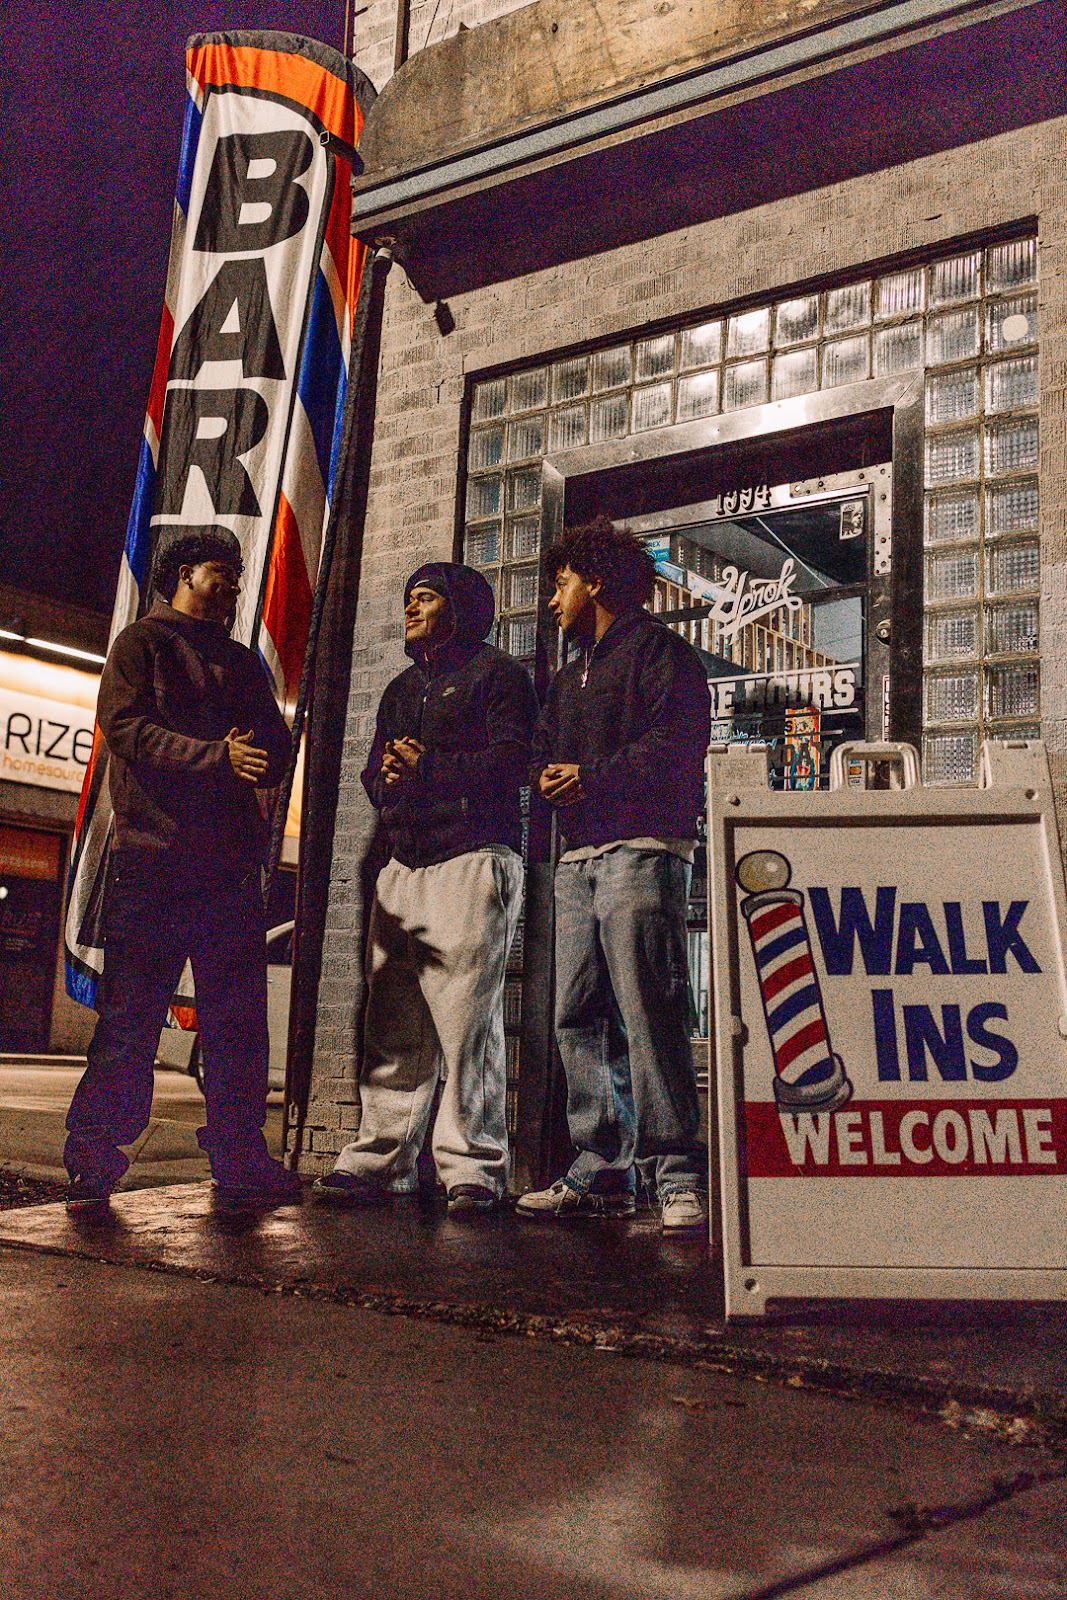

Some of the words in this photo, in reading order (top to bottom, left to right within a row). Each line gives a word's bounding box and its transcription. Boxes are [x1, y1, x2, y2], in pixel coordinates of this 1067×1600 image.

[716, 484, 772, 515] 1994
[745, 670, 856, 713] HOURS
[2, 752, 86, 782] homesourc
[807, 886, 1042, 976] WALK
[871, 988, 1019, 1082] INS
[779, 1107, 1057, 1166] WELCOME
